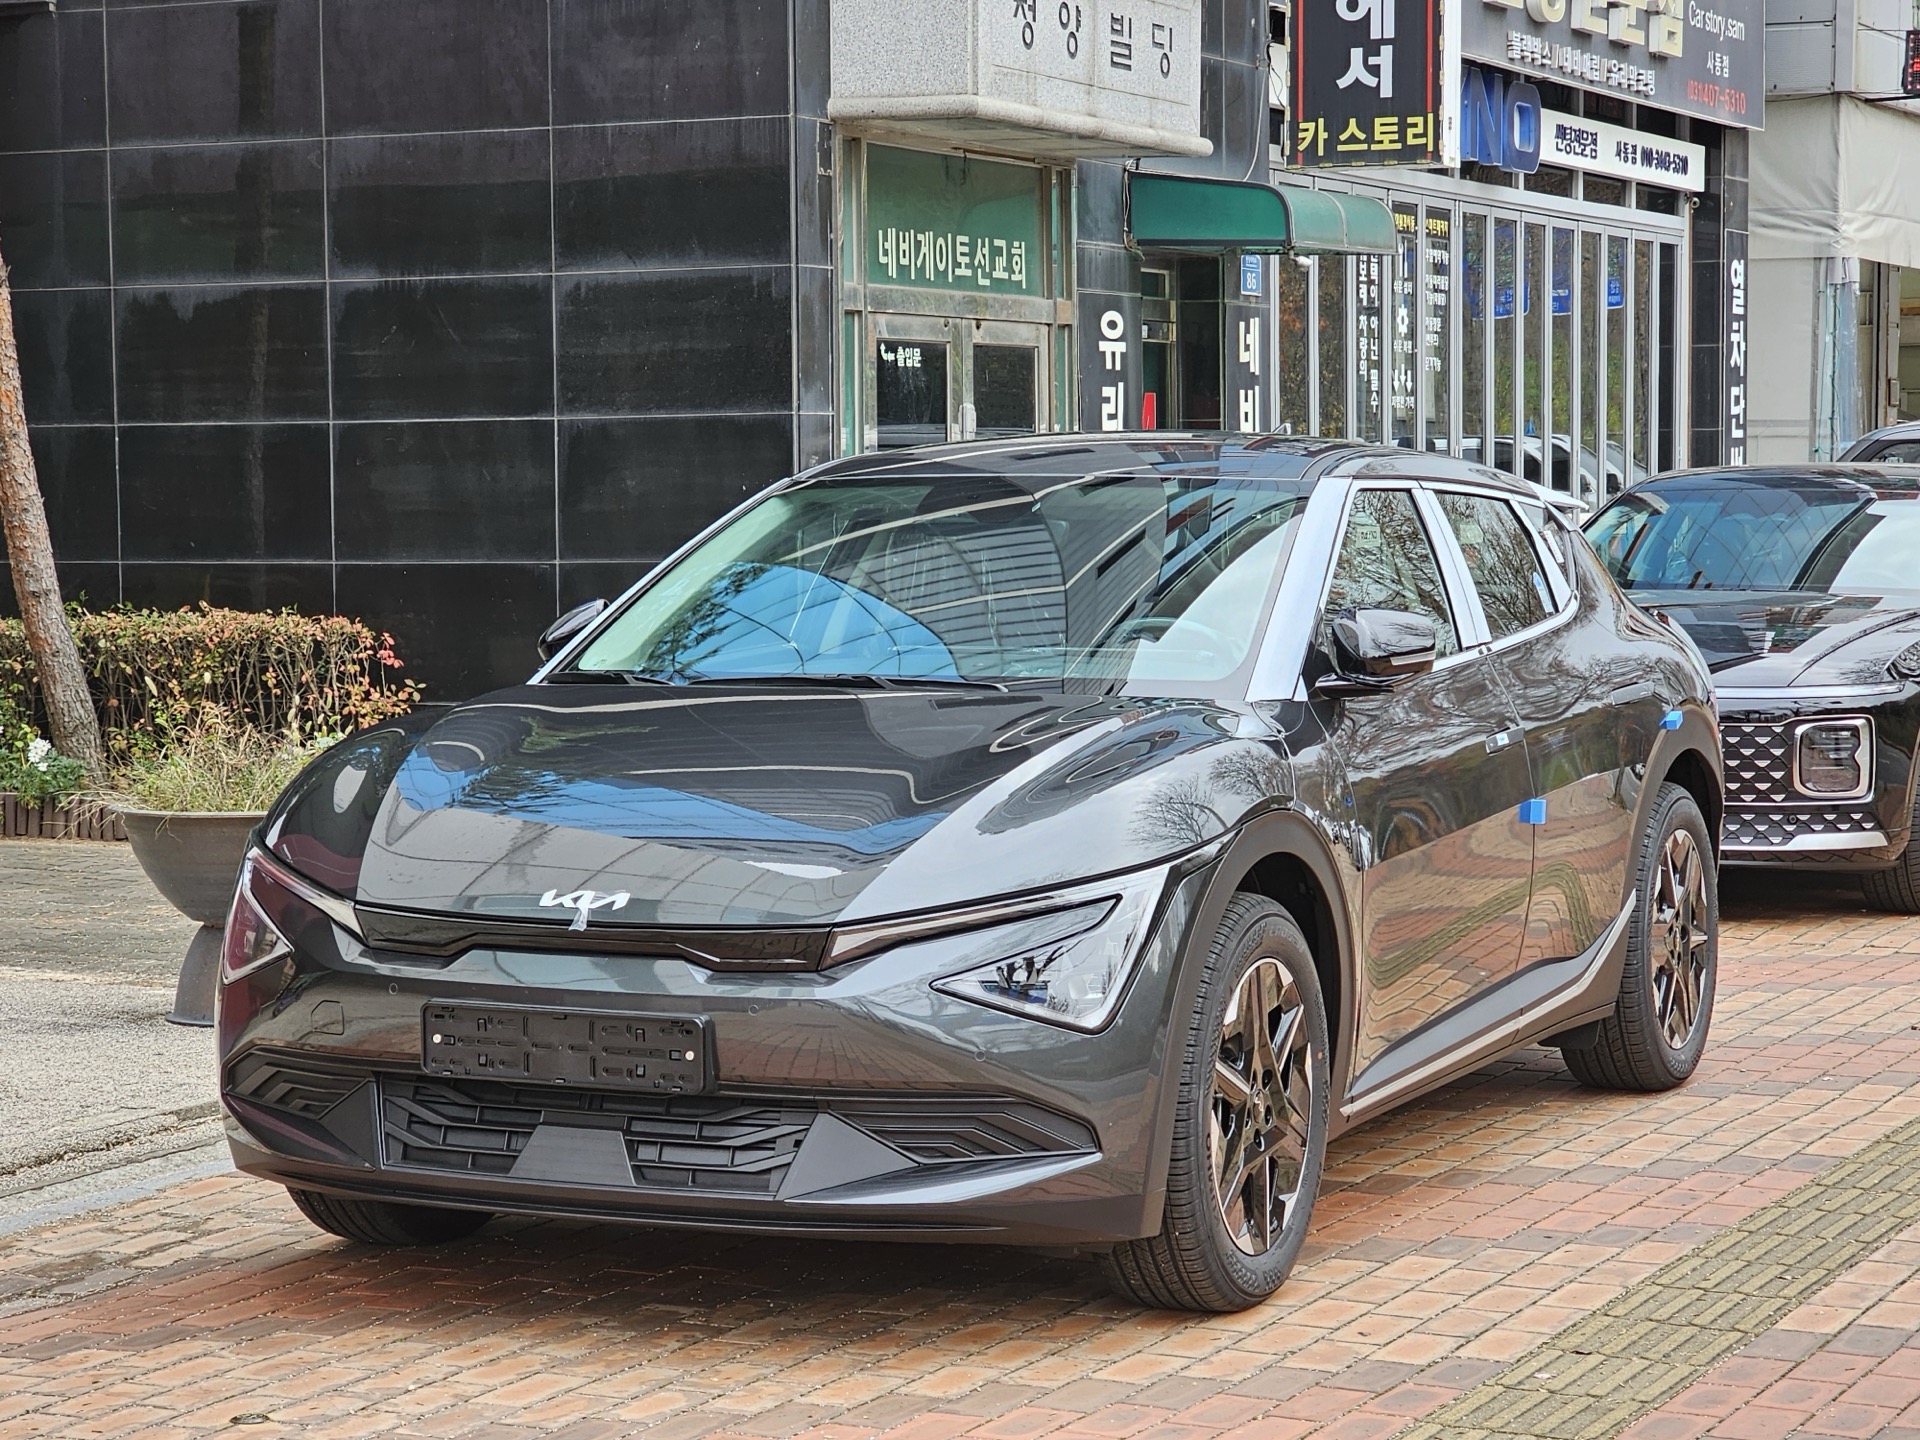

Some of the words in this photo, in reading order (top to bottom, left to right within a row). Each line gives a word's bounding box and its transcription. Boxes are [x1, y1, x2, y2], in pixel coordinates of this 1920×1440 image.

[1688, 0, 1705, 29] Car
[1507, 30, 1551, 65] 블랙박스
[1706, 50, 1729, 78] 사동점
[1615, 140, 1638, 166] 사동점
[878, 227, 1027, 289] 네비게이토선교회
[1246, 272, 1257, 290] 86
[896, 346, 922, 367] 출입문
[1099, 310, 1127, 431] 유리
[1239, 317, 1260, 432] 네비
